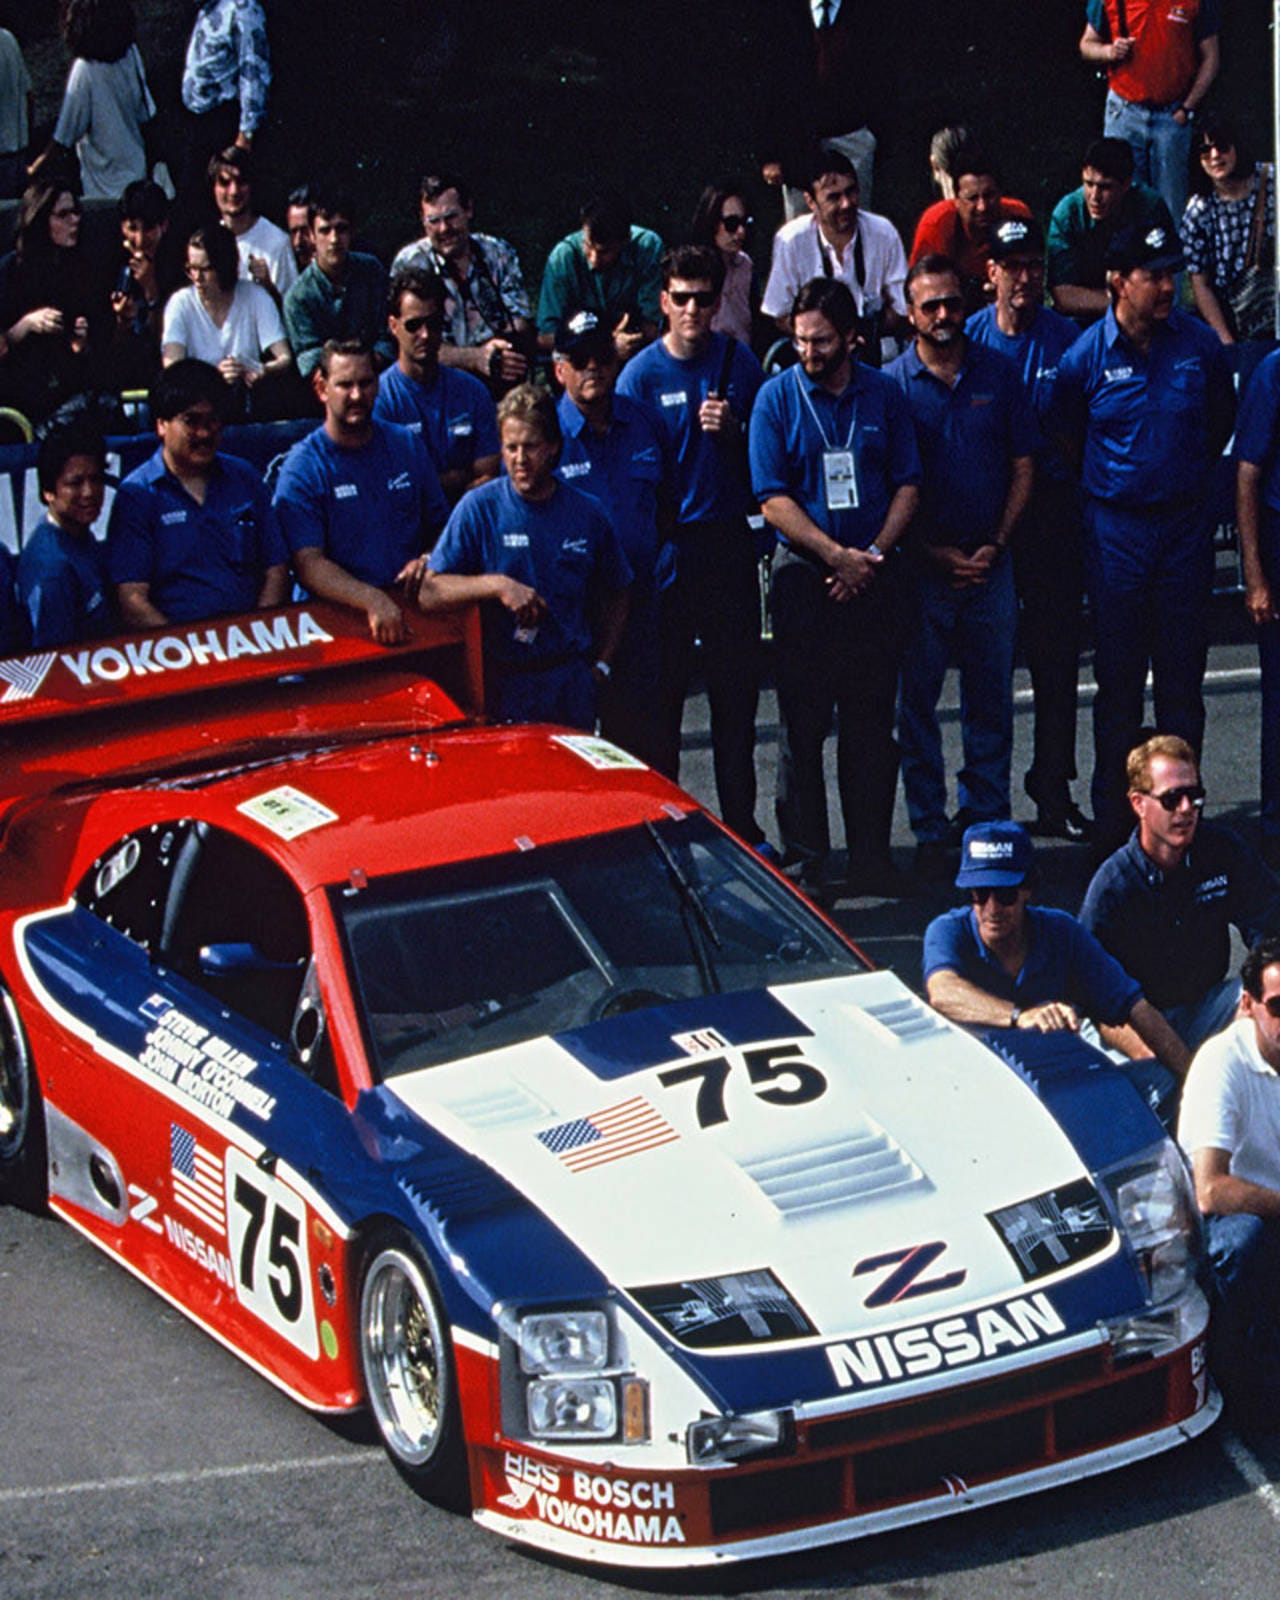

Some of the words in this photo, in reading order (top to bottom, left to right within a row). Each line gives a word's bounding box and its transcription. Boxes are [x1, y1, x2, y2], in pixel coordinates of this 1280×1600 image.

[62, 612, 333, 686] YOKOHAMA
[657, 1043, 828, 1129] 75
[164, 1214, 235, 1289] NISSAN
[234, 1173, 303, 1324] 75
[825, 1291, 1066, 1388] NISSAN
[535, 1491, 685, 1543] YOKOHAMA
[574, 1469, 675, 1510] BOSCH
